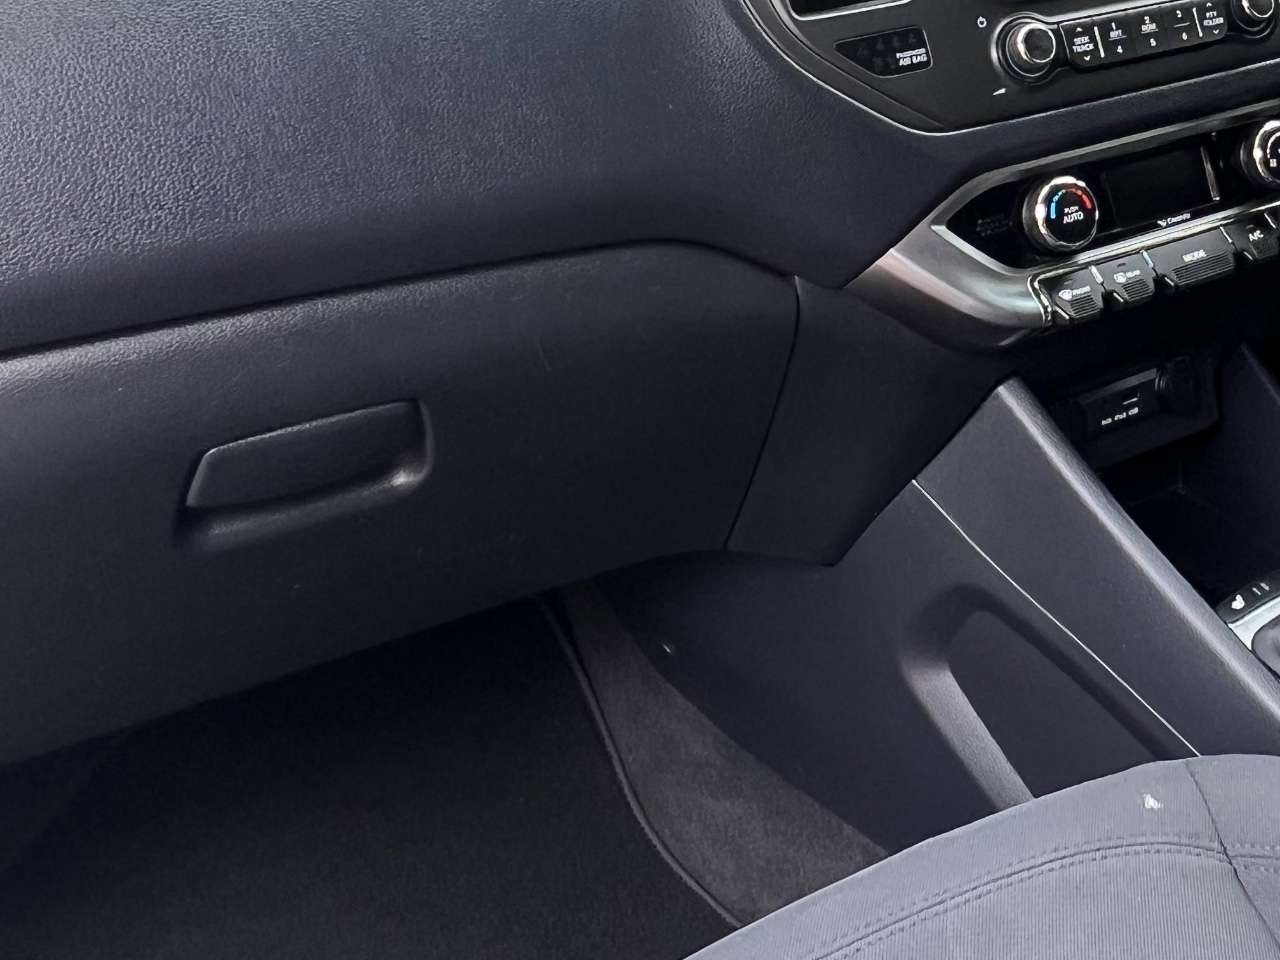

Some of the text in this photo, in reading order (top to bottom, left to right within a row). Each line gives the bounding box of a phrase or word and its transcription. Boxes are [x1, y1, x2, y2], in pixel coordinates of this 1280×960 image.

[1143, 16, 1150, 24] 2
[1149, 38, 1157, 47] 5
[1072, 43, 1095, 54] TRACK
[1116, 45, 1123, 54] 4
[1063, 211, 1084, 224] AUTO
[1248, 229, 1264, 242] A/C
